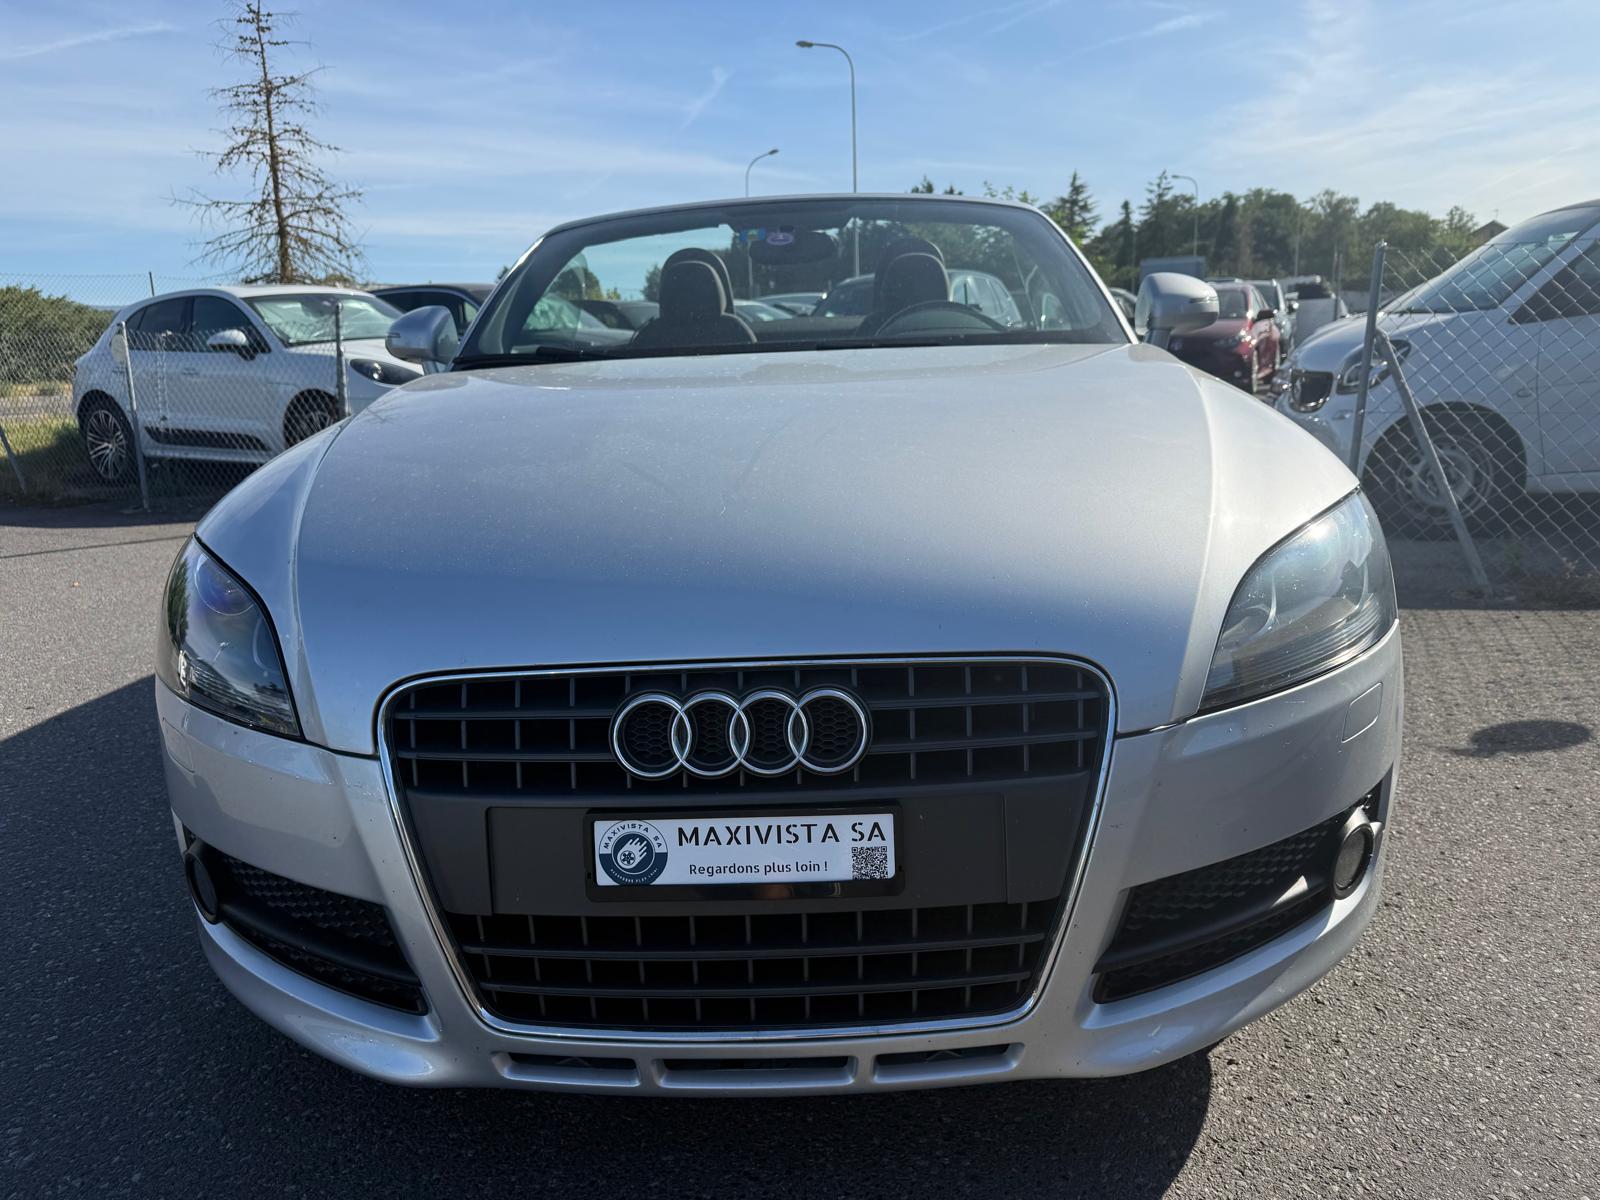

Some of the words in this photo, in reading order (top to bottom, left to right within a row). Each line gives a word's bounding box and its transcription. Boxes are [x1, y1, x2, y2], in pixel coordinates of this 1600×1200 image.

[603, 824, 649, 849] MAXIVISTA
[653, 836, 662, 848] SA
[678, 823, 840, 846] MAXIVISTA
[851, 822, 886, 842] SA
[689, 863, 760, 876] Regardons
[764, 862, 792, 874] plus
[796, 861, 820, 872] loin
